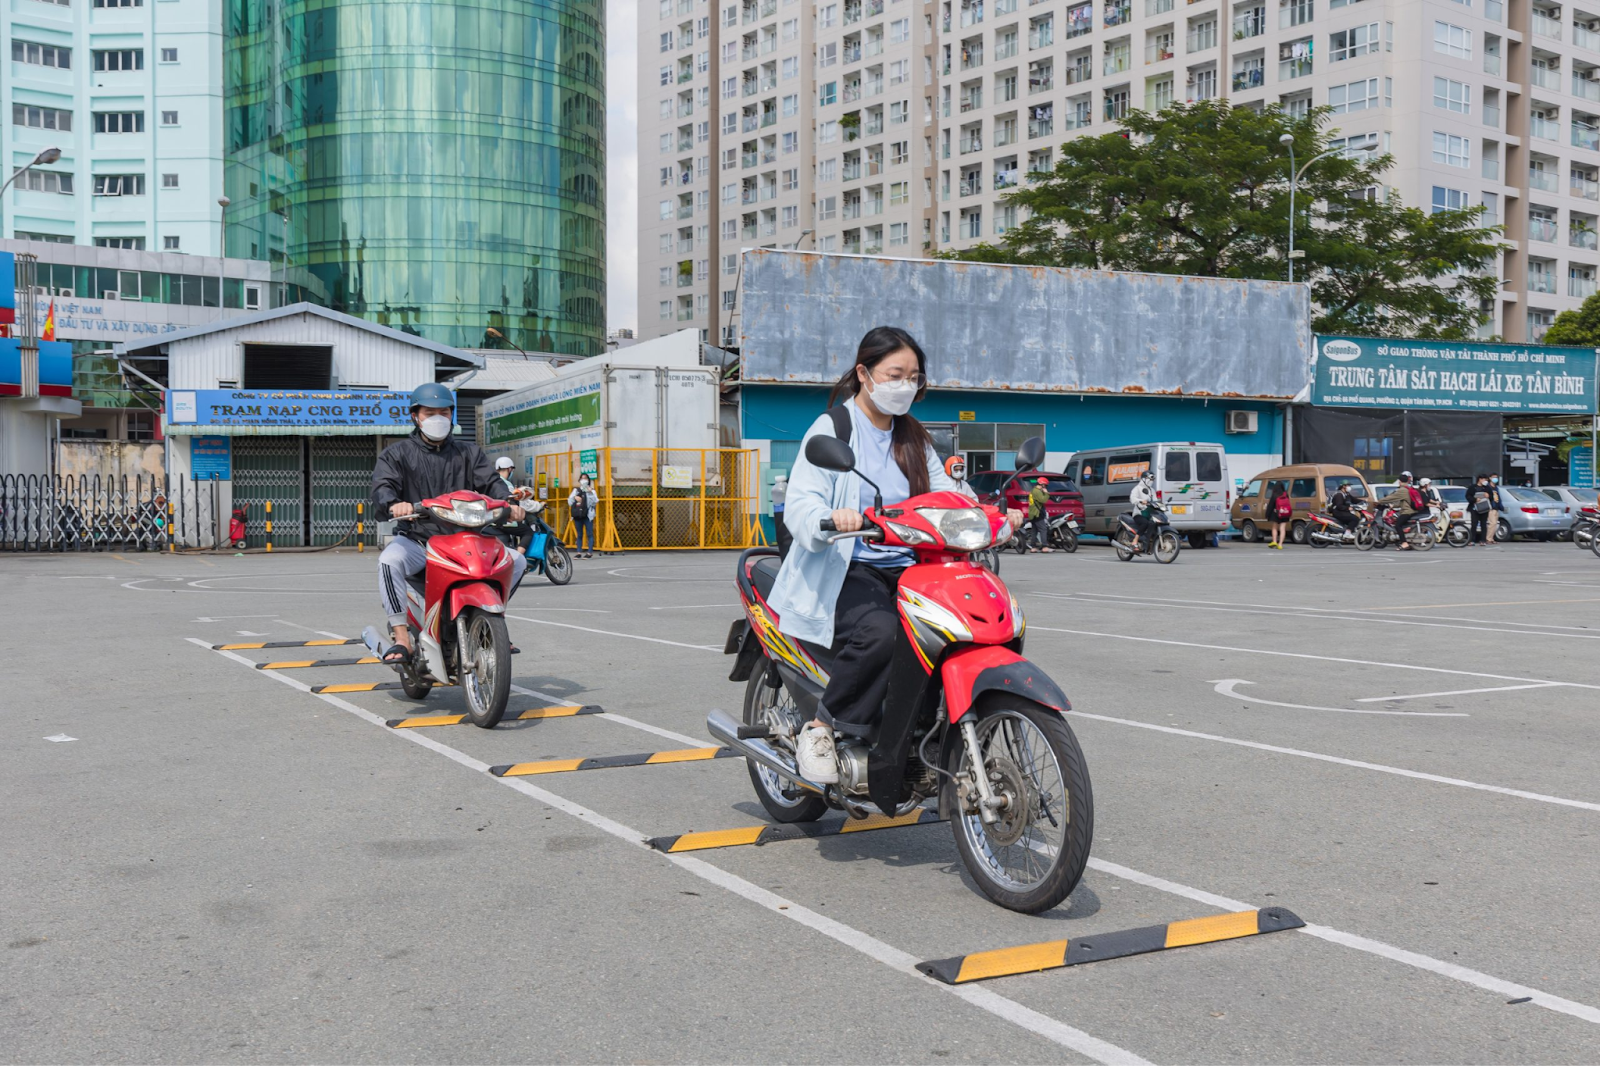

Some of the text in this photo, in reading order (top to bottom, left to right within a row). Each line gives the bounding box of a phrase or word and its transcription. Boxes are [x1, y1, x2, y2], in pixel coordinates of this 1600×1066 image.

[61, 303, 79, 315] VIỆT
[82, 306, 102, 315] NAM
[59, 316, 78, 329] ĐẦU
[81, 320, 93, 330] TƯ
[97, 318, 109, 331] VÀ
[111, 321, 130, 333] XÂY
[132, 324, 157, 335] DỰNG
[1326, 345, 1358, 356] SaigonBus
[1377, 344, 1388, 356] SỞ
[1390, 347, 1409, 357] GIAO
[1411, 347, 1438, 358] THÔNG
[1440, 348, 1456, 360] VẬN
[1457, 348, 1471, 360] TẢI
[1473, 350, 1499, 361] THÀNH
[1500, 350, 1517, 362] PHỐ
[1530, 352, 1544, 363] CHÍ
[1545, 354, 1566, 364] MINH
[1329, 363, 1585, 395] TRUNG TÂM SÁT HẠCH LÁI XE TÂN BÌNH
[589, 382, 600, 391] NAM
[383, 392, 403, 400] MIỀN
[210, 401, 411, 418] TRẠM NẠP CNG PHỔ QU
